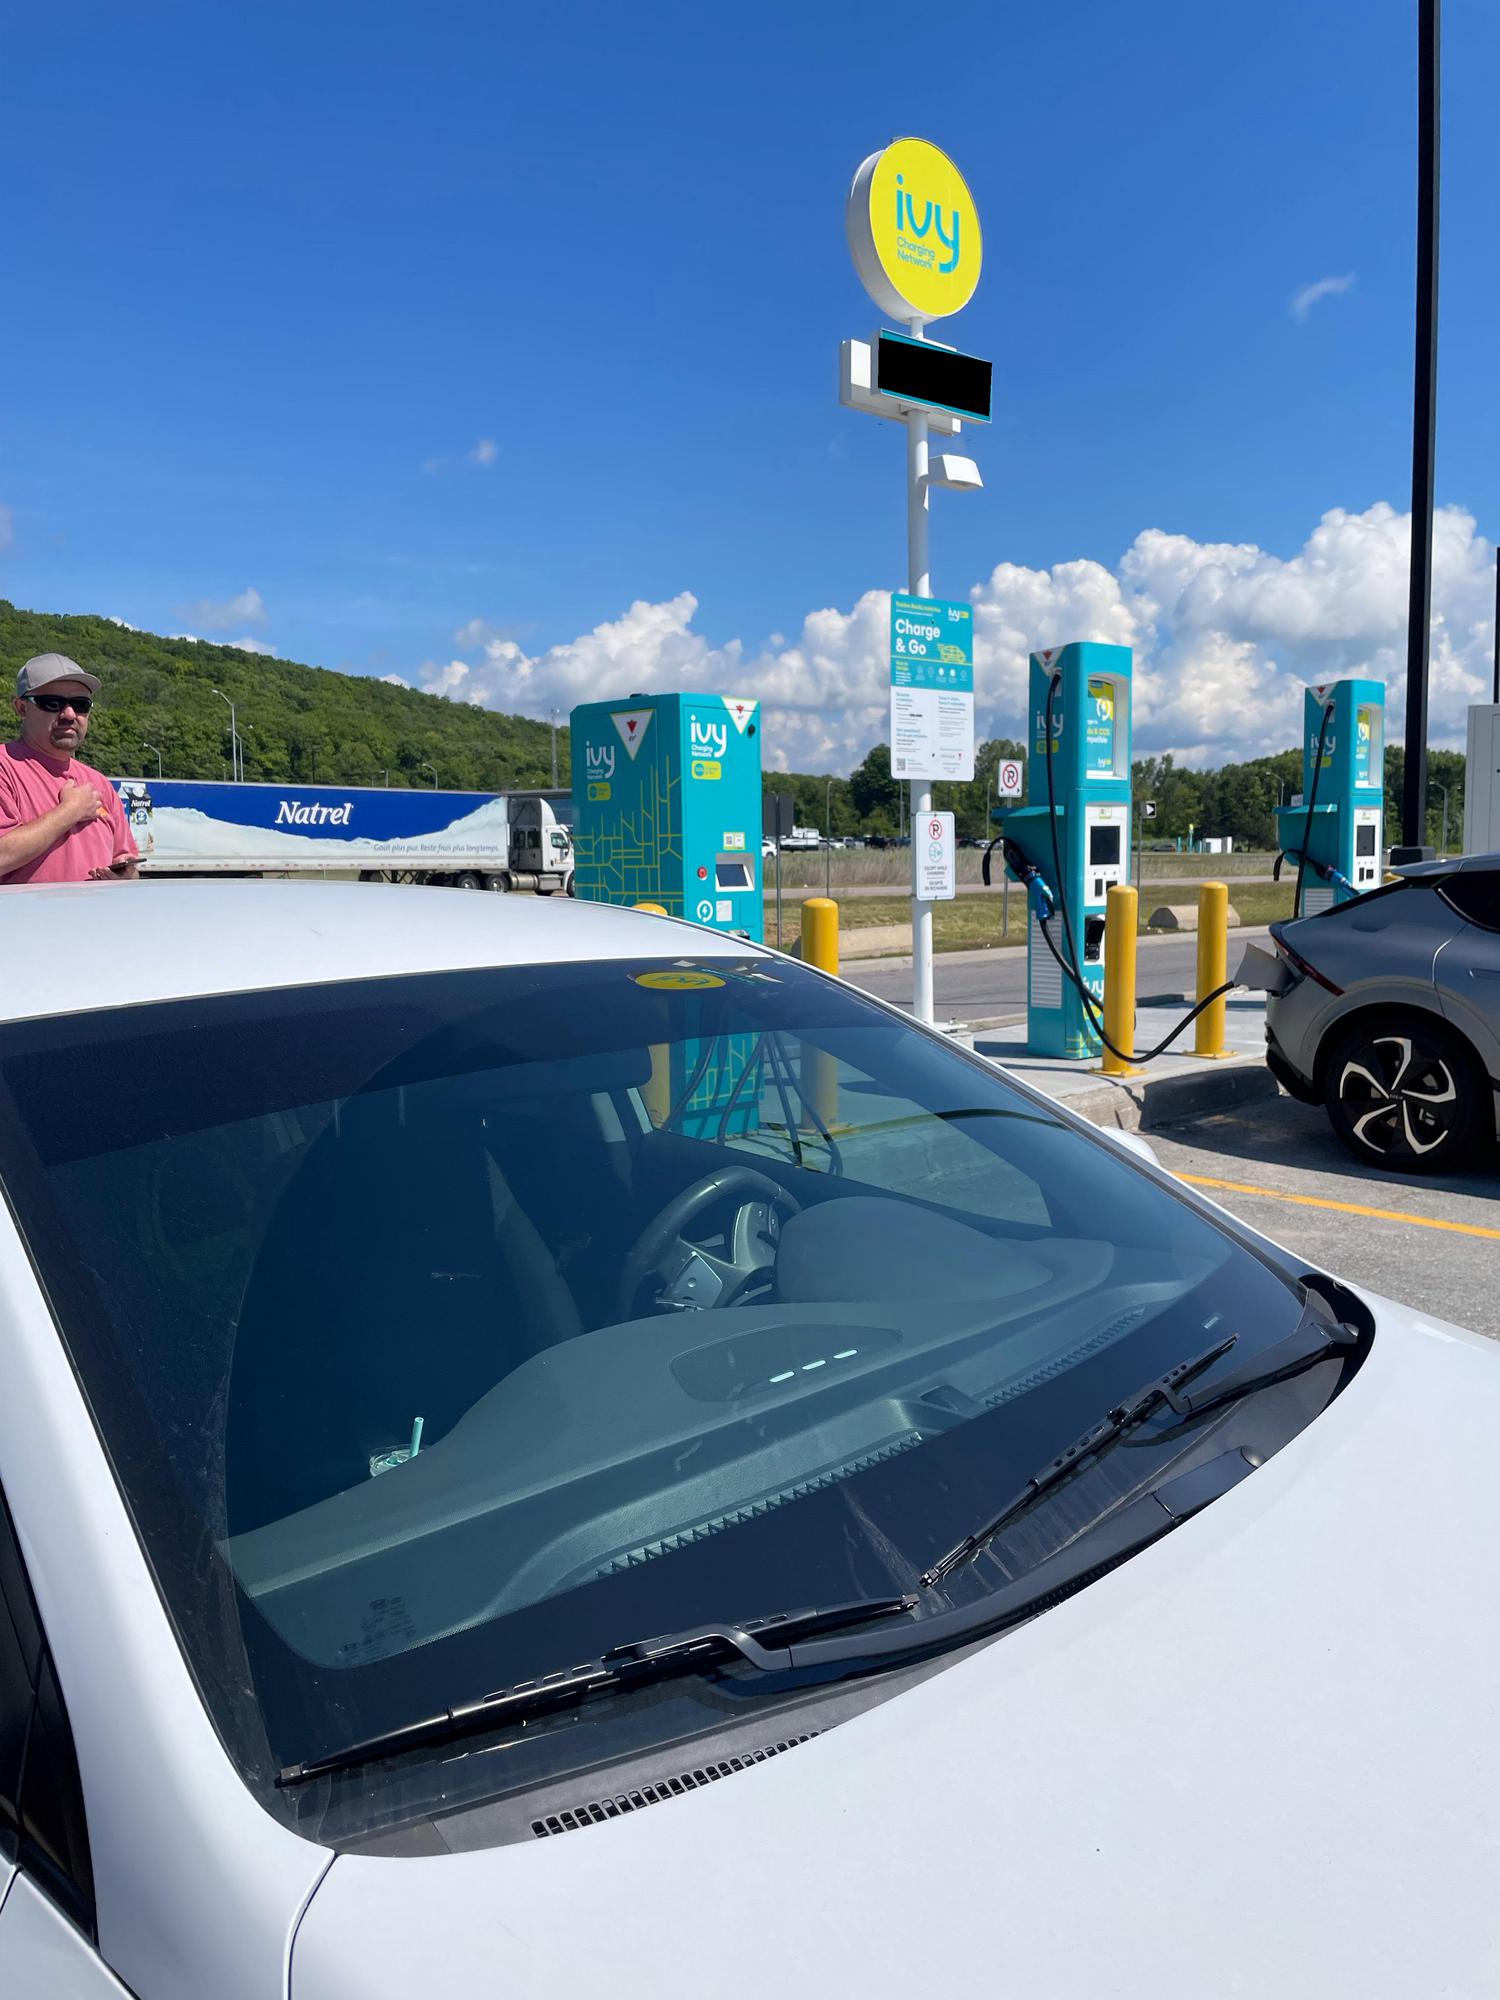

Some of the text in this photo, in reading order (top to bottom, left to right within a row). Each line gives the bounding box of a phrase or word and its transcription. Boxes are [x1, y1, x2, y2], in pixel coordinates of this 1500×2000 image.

[896, 173, 960, 273] ivy
[897, 236, 935, 261] Charging
[897, 249, 934, 270] Network
[895, 618, 941, 641] Charge
[896, 637, 927, 655] & Go
[690, 714, 727, 758] ivy
[586, 740, 615, 779] ivy
[274, 800, 352, 825] Natrel
